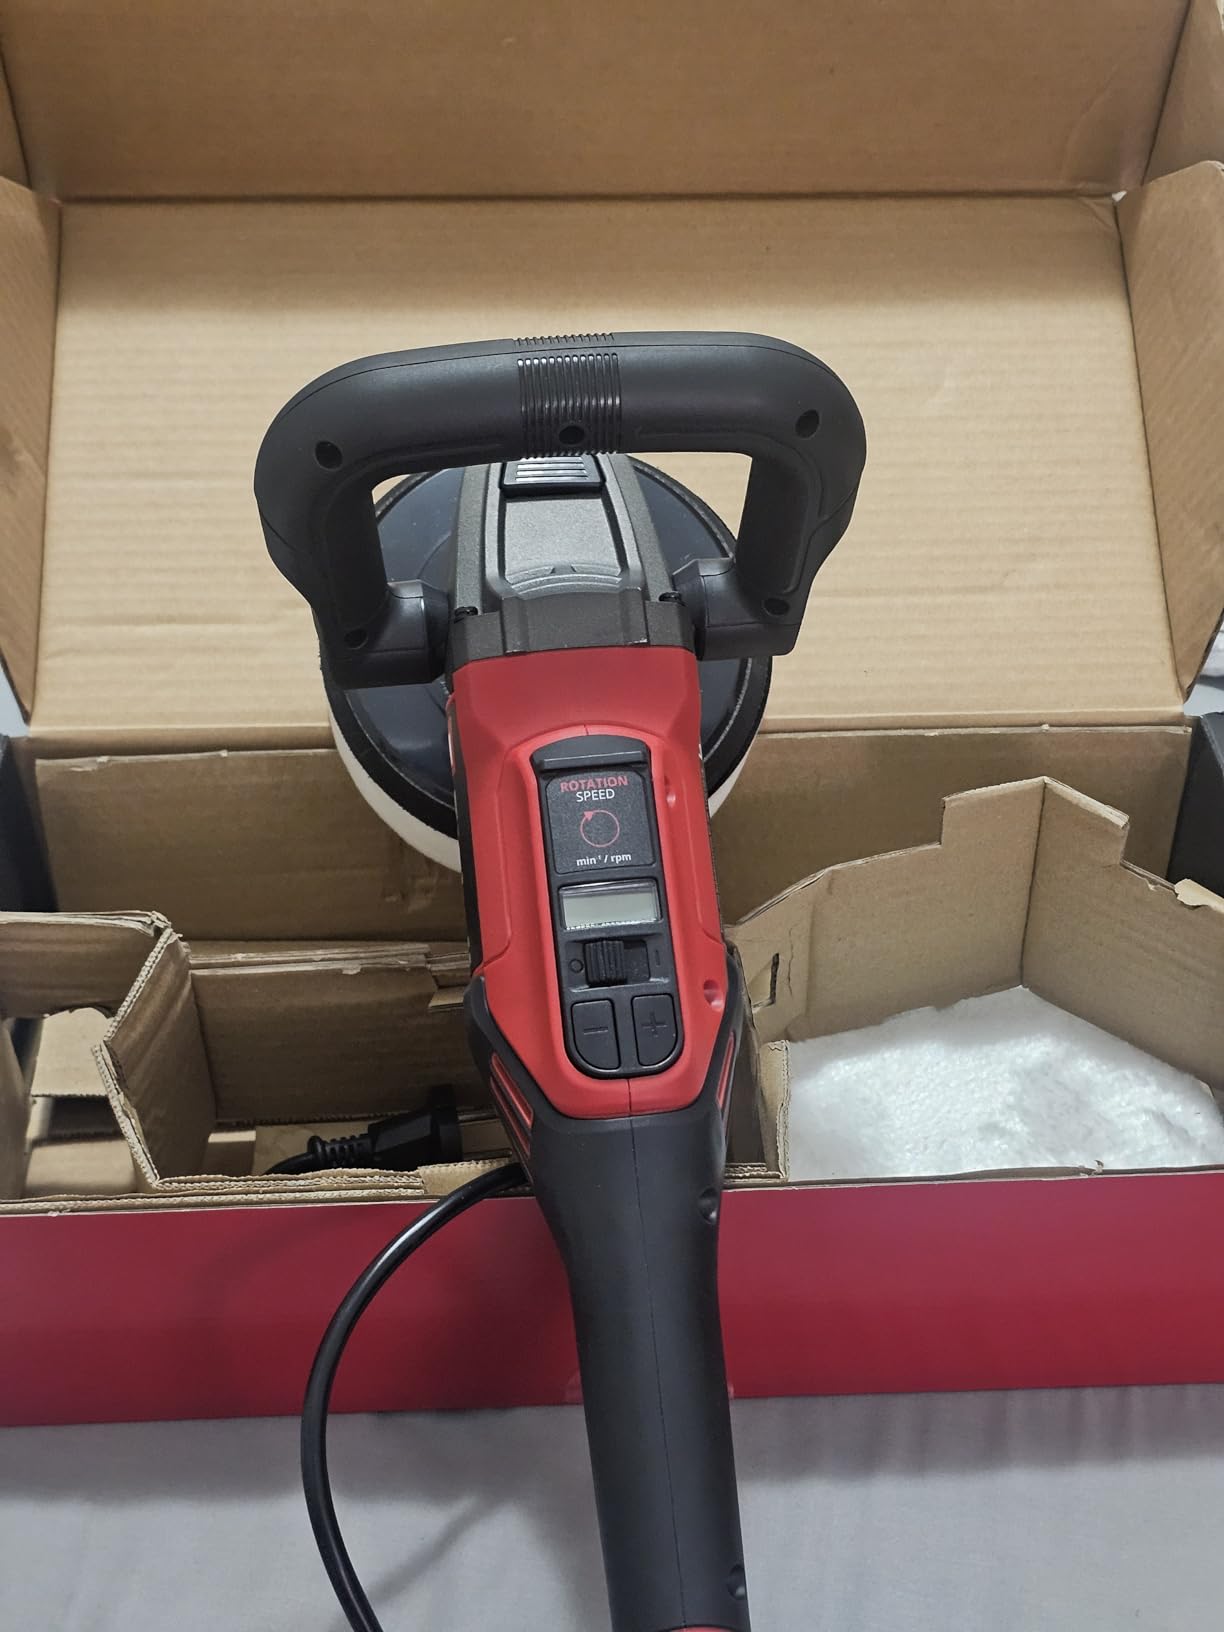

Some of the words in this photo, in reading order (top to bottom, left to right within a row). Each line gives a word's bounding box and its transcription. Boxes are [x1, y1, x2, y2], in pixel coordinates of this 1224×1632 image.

[560, 776, 628, 792] ROTATION
[576, 789, 615, 802] SPEED
[610, 853, 632, 864] rpm
